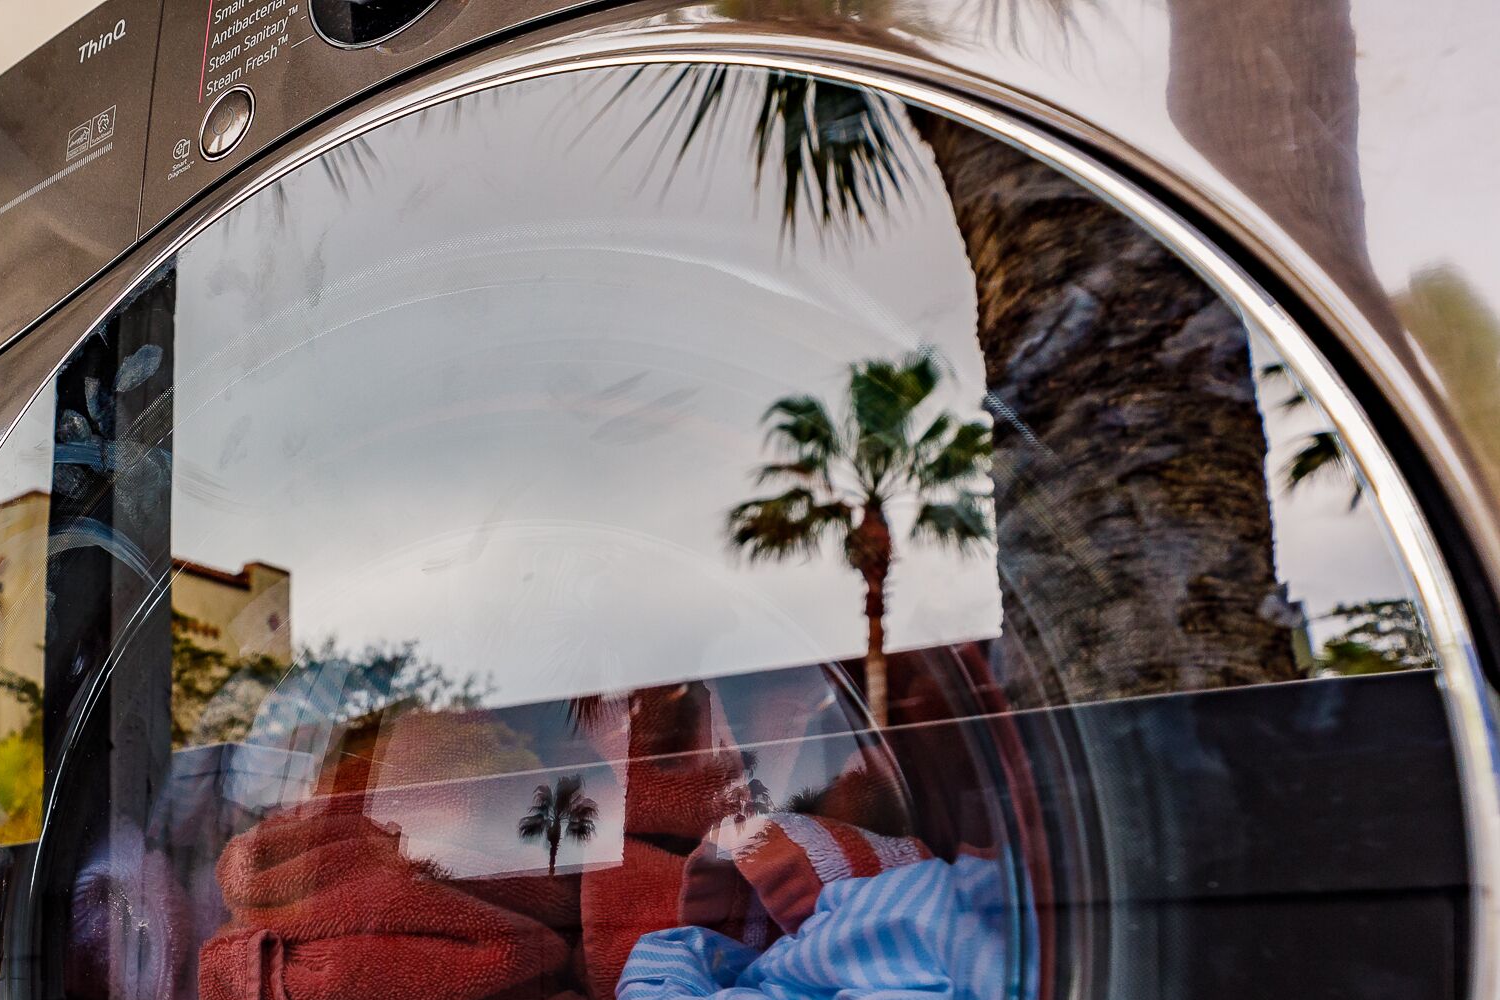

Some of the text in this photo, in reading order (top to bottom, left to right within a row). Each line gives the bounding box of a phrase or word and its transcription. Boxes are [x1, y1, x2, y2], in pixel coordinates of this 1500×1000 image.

[79, 19, 126, 63] ThinQ
[208, 48, 240, 73] Steam
[205, 68, 242, 97] Steam
